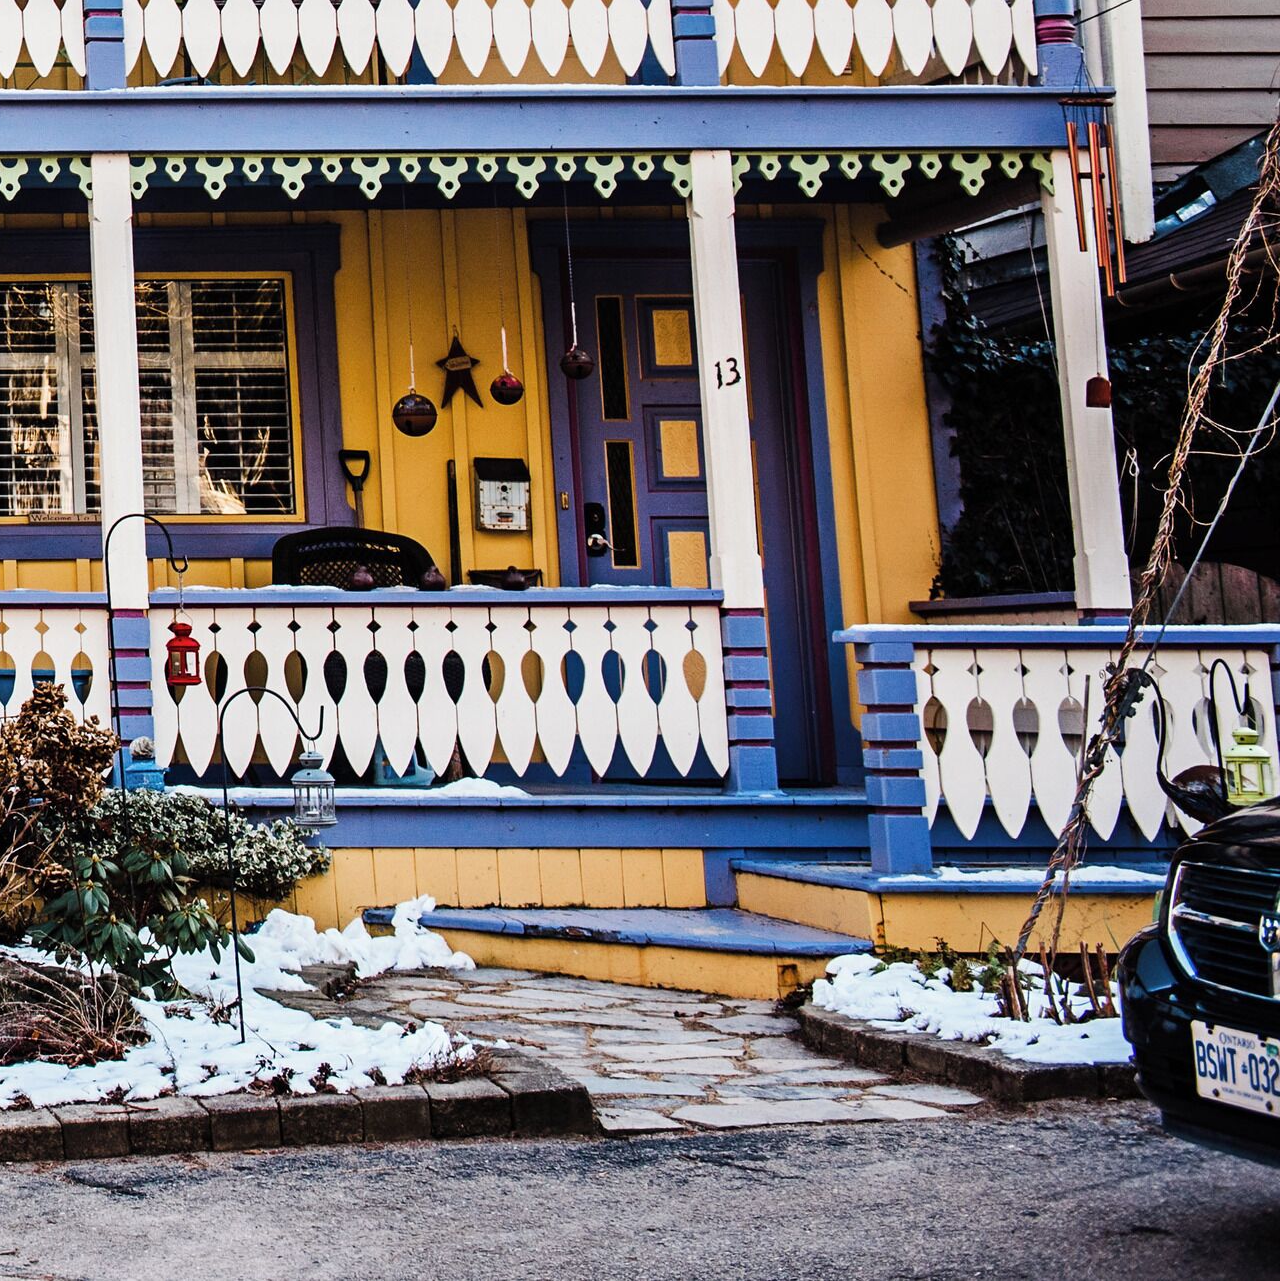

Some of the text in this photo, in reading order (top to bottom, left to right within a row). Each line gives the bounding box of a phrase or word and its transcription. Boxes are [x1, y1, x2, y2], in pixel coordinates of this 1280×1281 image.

[714, 357, 741, 389] 13
[31, 513, 72, 522] Welcome
[1219, 1031, 1256, 1050] ONTARIO
[1195, 1040, 1280, 1097] BSWT 032
